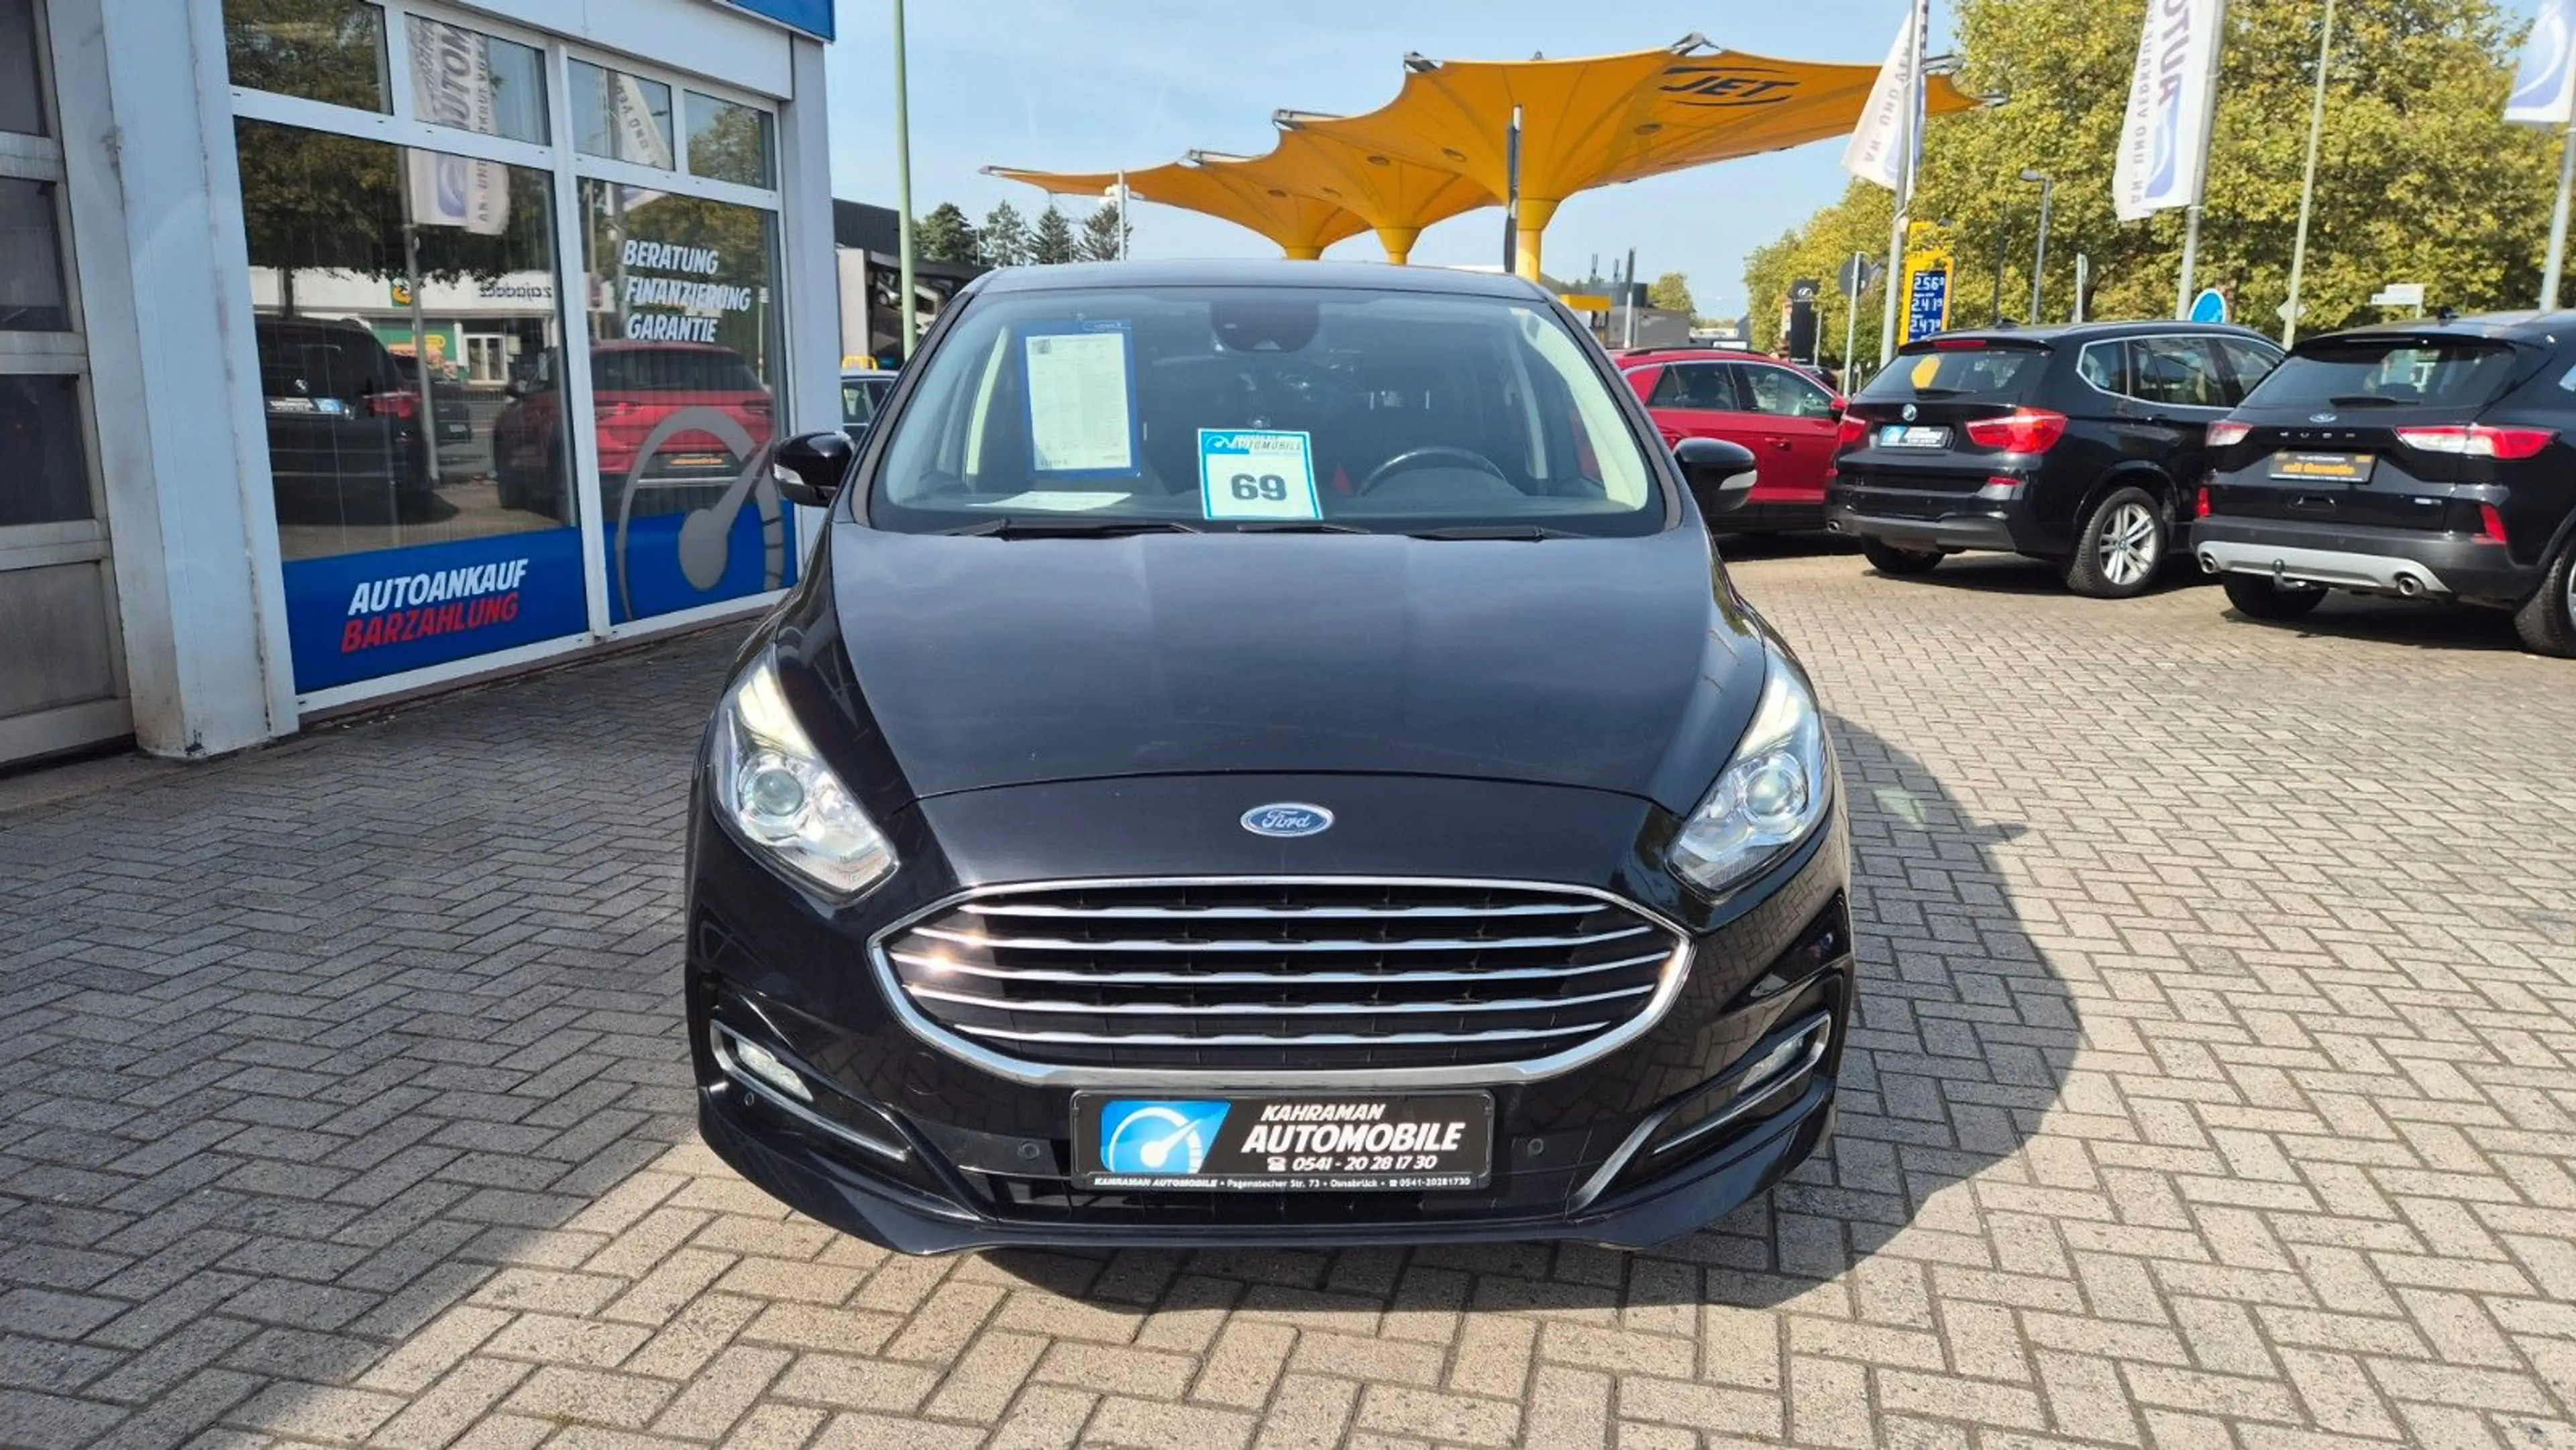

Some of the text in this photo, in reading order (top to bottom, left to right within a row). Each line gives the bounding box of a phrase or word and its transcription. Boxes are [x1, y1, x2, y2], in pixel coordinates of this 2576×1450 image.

[623, 239, 720, 275] BERATUNG
[625, 275, 752, 312] FINANZIERUNG
[627, 313, 718, 343] GARANTIE
[1231, 473, 1287, 501] 69
[347, 559, 529, 616] AUTOANKAUF
[341, 592, 520, 654] BARZAHLUNG
[1261, 808, 1311, 828] Ford
[1260, 1104, 1386, 1121] KAHRAMAN
[1241, 1122, 1466, 1154] AUTOMOBILE
[1292, 1156, 1333, 1171] 0541
[1344, 1156, 1369, 1171] 20
[1370, 1156, 1393, 1170] 28
[1395, 1156, 1413, 1170] 17
[1413, 1155, 1438, 1170] 30
[1093, 1177, 1150, 1186] KAHRAMAN
[1152, 1178, 1218, 1187] AUTOMOBILE
[1290, 1179, 1306, 1188] Str.
[1308, 1179, 1321, 1188] 73
[1330, 1178, 1379, 1188] Osnabrück
